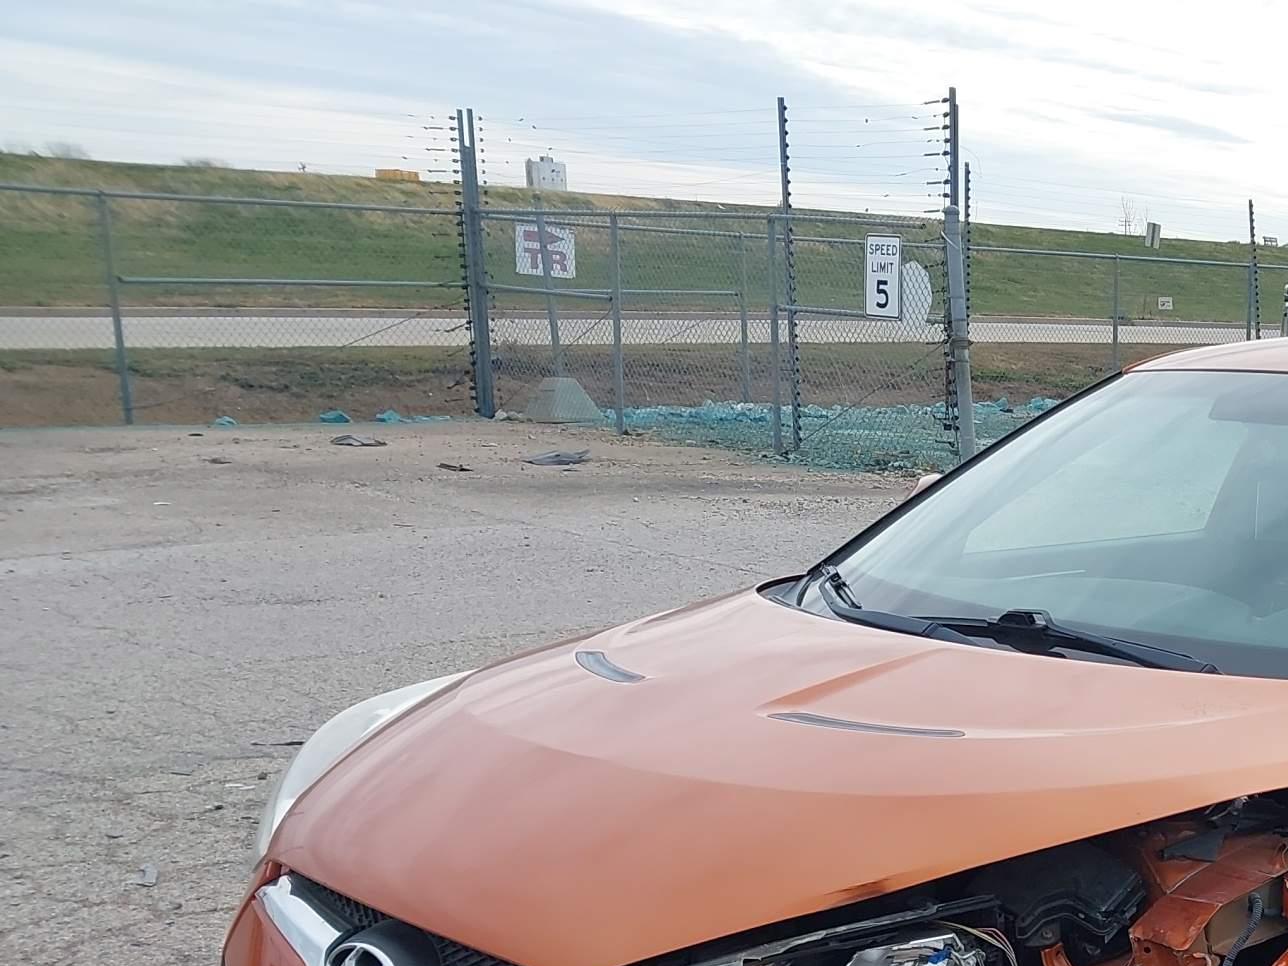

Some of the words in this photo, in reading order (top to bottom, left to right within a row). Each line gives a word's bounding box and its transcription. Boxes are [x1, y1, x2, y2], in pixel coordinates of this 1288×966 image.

[869, 243, 898, 257] SPEED
[872, 261, 894, 274] LIMIT
[876, 280, 889, 309] 5
